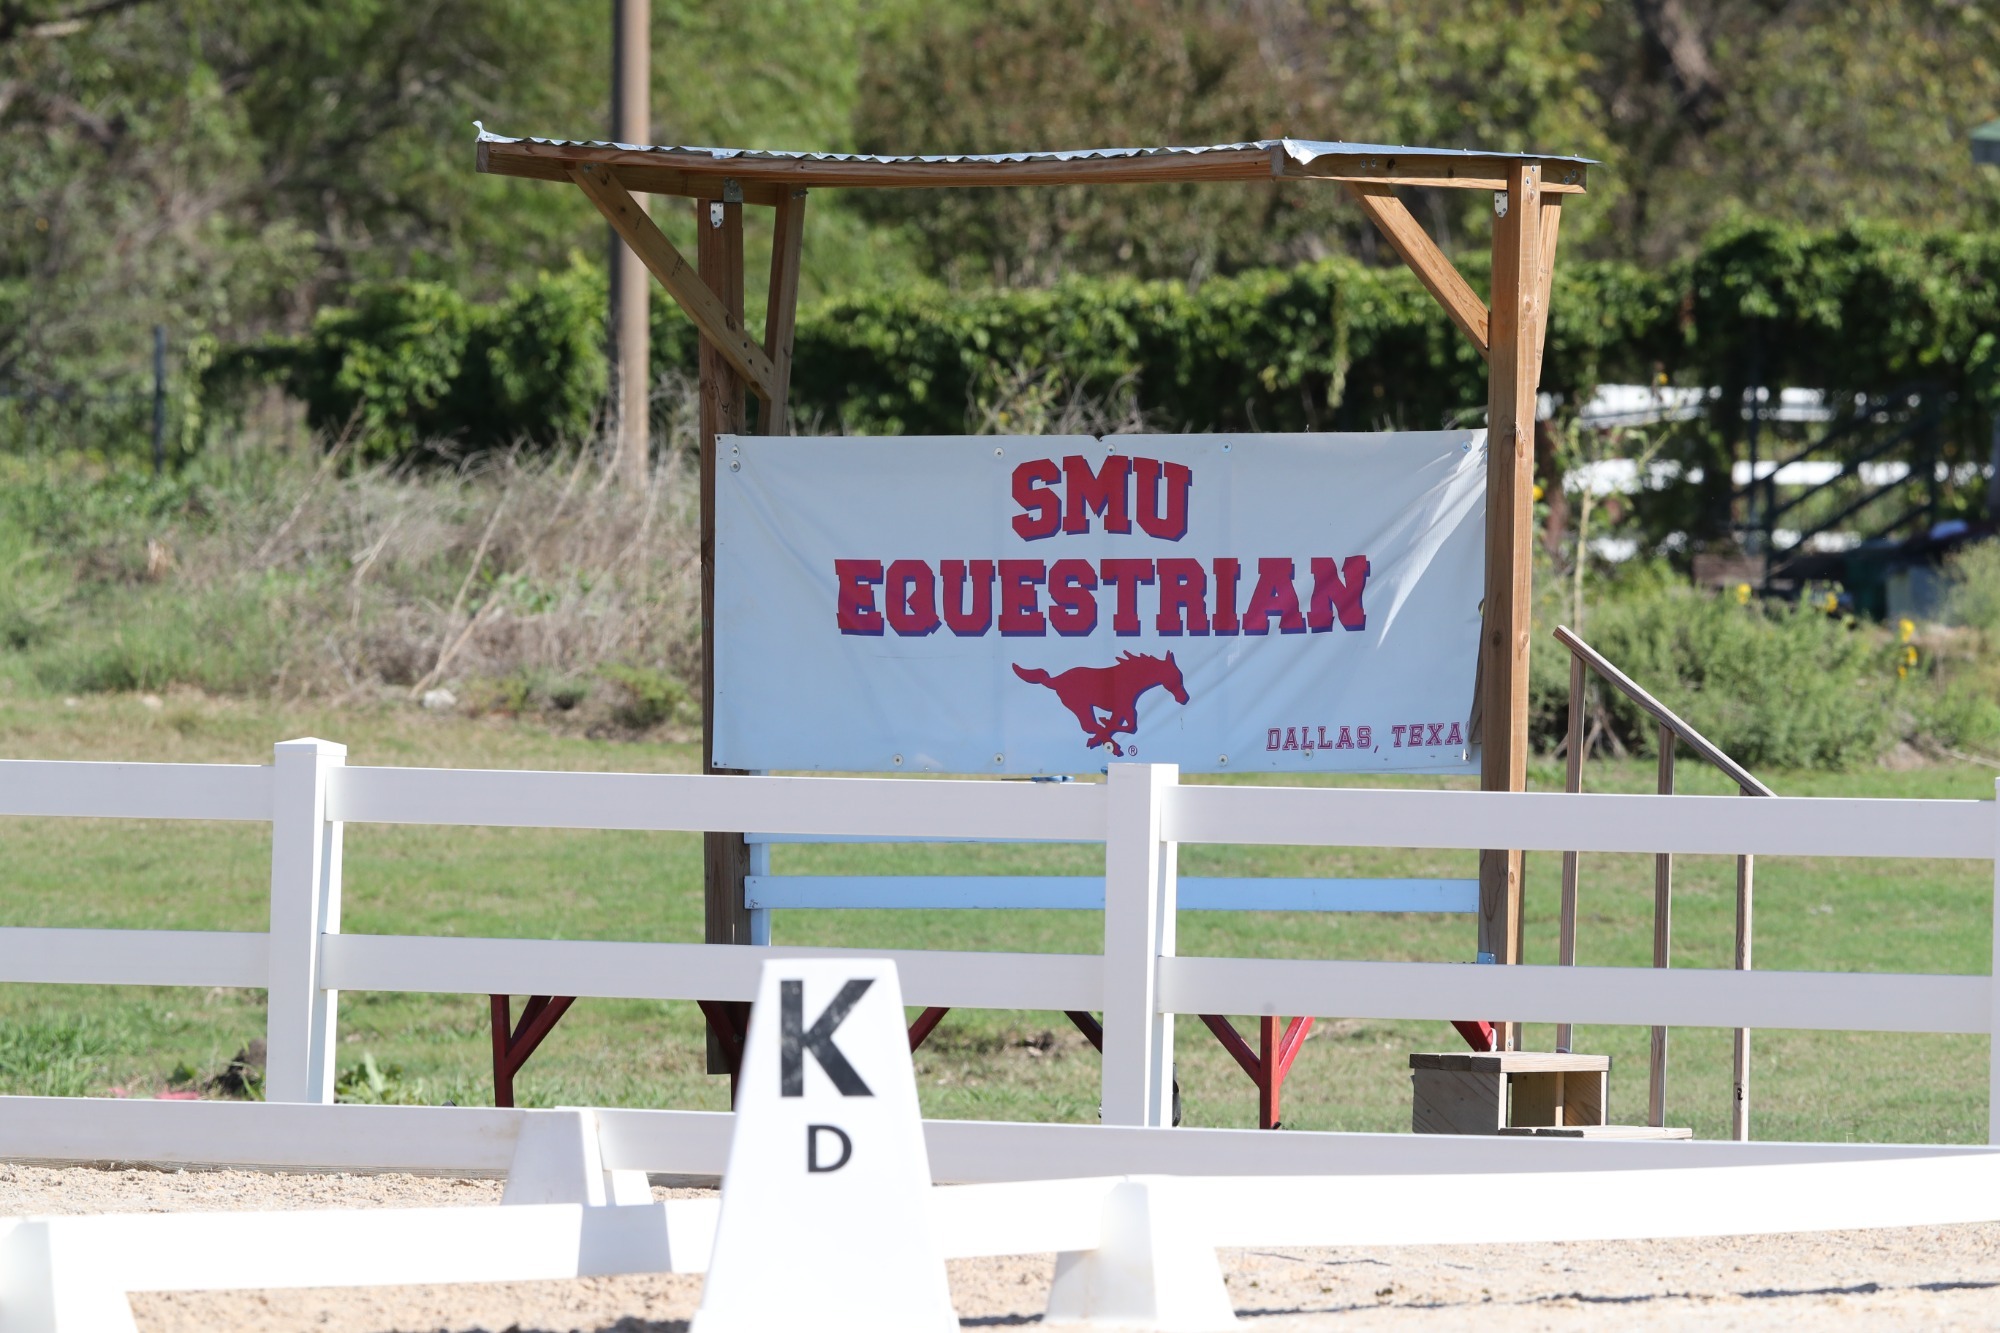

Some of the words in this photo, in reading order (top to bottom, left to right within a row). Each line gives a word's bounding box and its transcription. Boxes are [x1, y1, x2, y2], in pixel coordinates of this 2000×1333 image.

[1012, 455, 1193, 541] SMU
[834, 555, 1371, 637] EQUESTRIAN
[1266, 726, 1380, 753] DALLAS,
[1391, 721, 1470, 748] TEXA
[779, 978, 876, 1098] K
[807, 1124, 852, 1173] D
